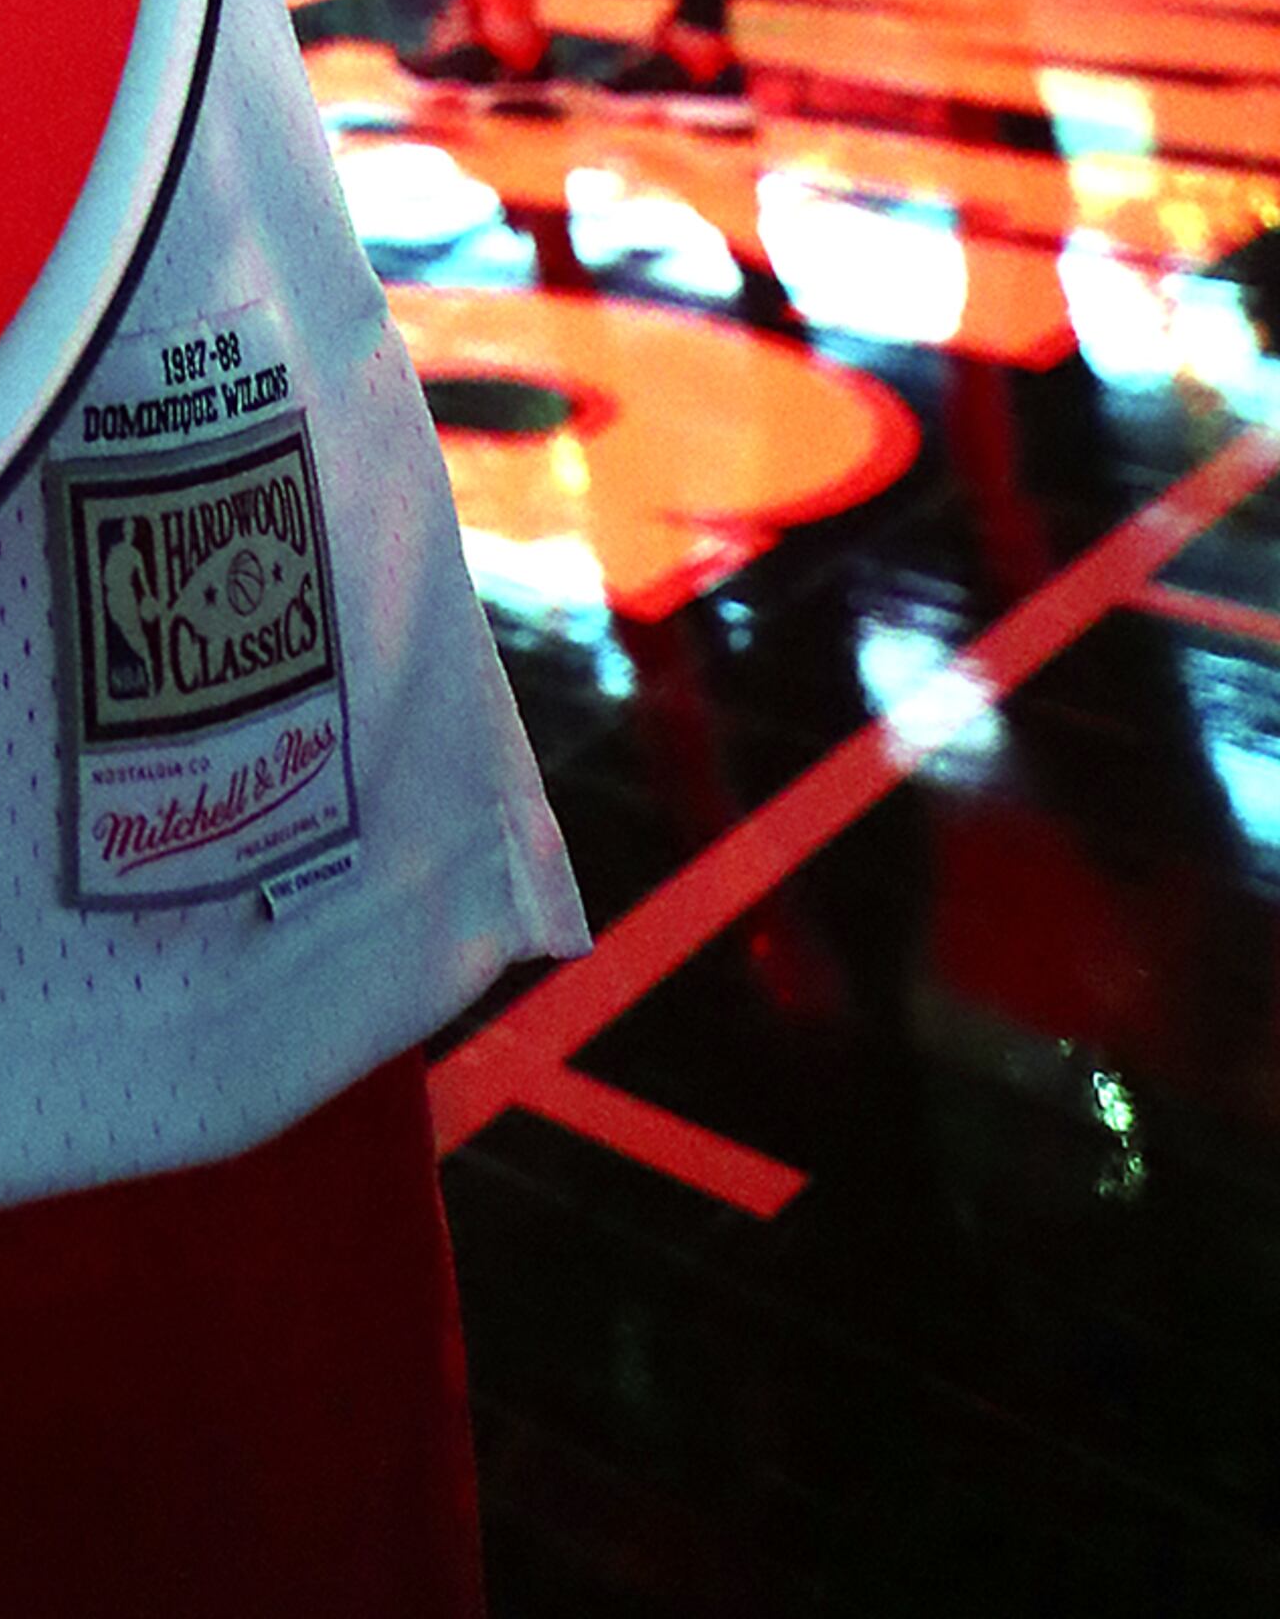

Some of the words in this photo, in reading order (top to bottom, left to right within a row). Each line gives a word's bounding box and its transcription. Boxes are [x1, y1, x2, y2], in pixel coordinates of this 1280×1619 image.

[83, 386, 220, 443] DOMINIQUE
[221, 362, 289, 418] WILKINS
[161, 330, 242, 386] 1987-88
[160, 475, 307, 610] HARDWOOD
[91, 764, 249, 862] Mitchell
[252, 755, 276, 802] &
[273, 718, 337, 786] Ness
